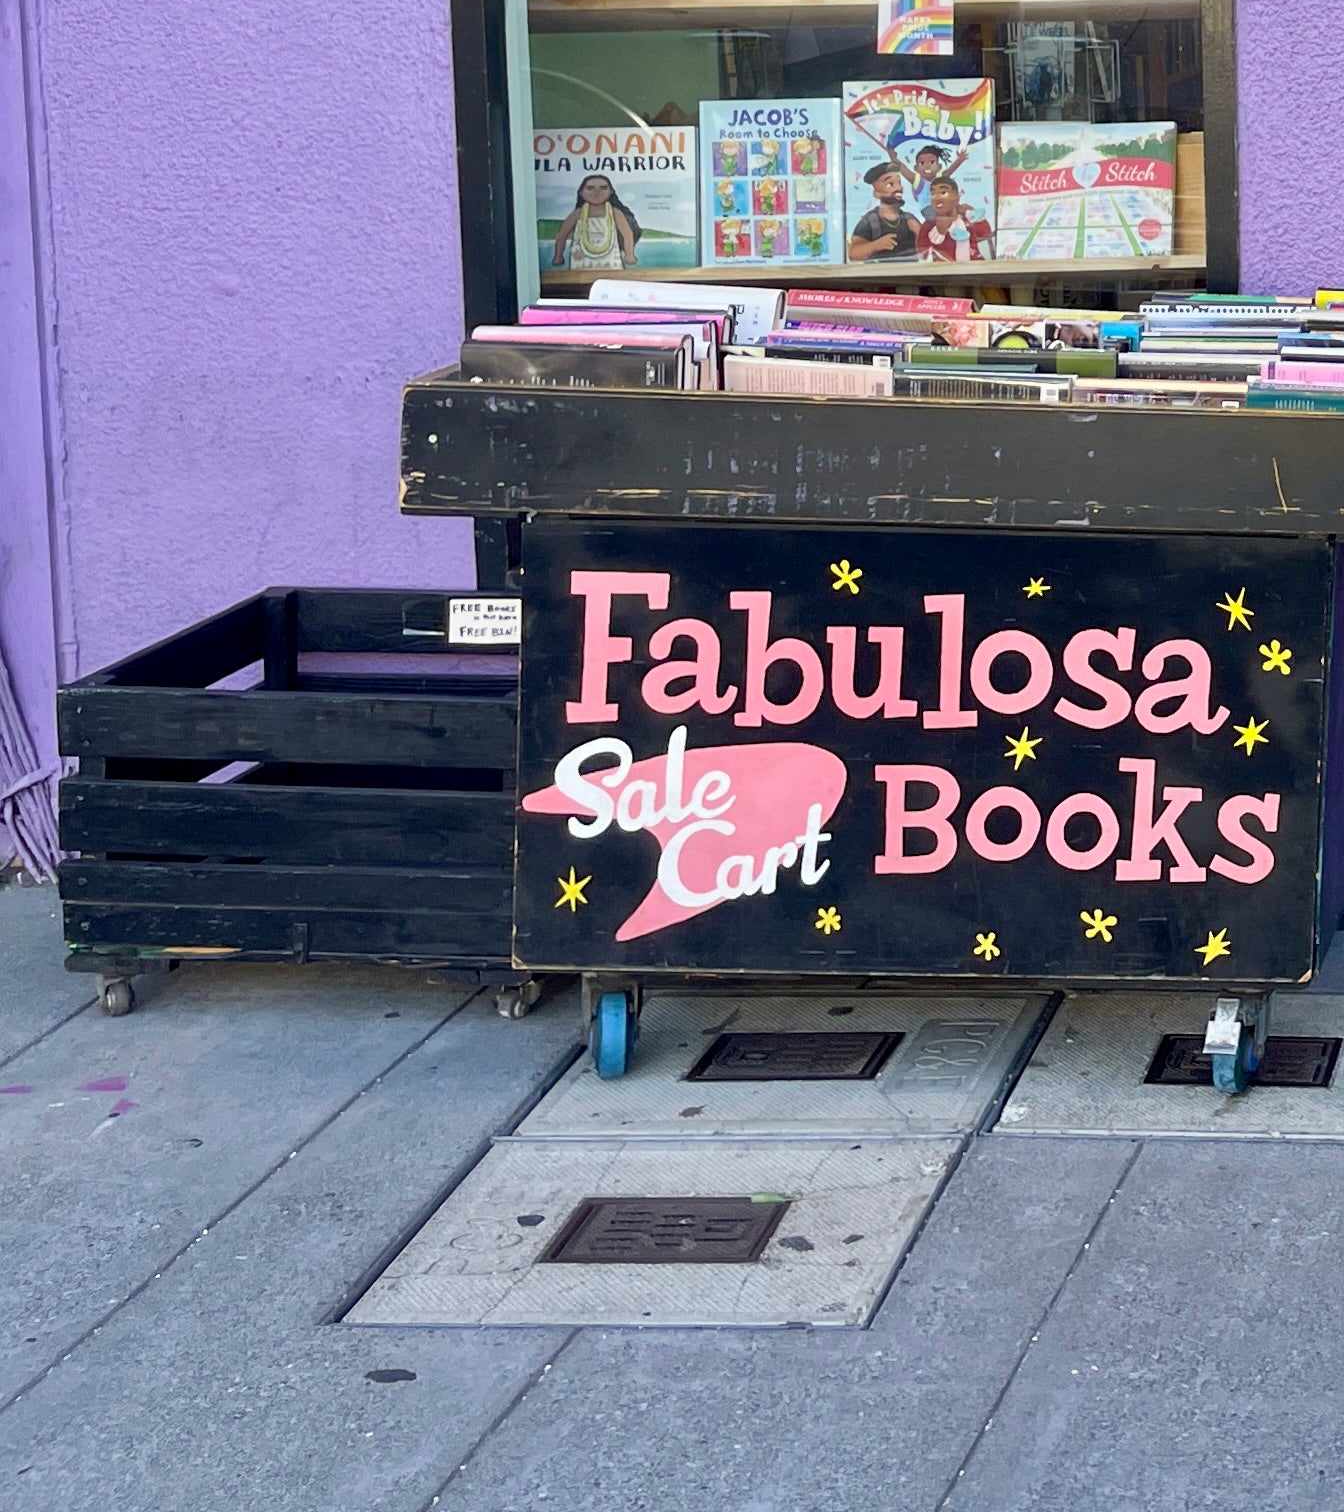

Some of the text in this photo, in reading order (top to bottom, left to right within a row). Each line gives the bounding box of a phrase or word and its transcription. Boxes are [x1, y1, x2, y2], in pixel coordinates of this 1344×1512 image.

[862, 88, 940, 115] It's Pride,
[728, 108, 809, 127] JACOB'S
[903, 105, 983, 155] Baby!
[534, 132, 685, 155] O'ONANI
[720, 127, 818, 139] Room to Choose
[583, 156, 686, 173] WARRIOR
[1020, 170, 1068, 194] Stitch
[1105, 161, 1157, 182] Stitch
[453, 604, 481, 613] FREE
[460, 626, 487, 637] FREE
[565, 571, 1230, 733] Fabulosa
[553, 725, 736, 839] Sale
[874, 758, 1281, 885] Books
[656, 803, 833, 909] Cart
